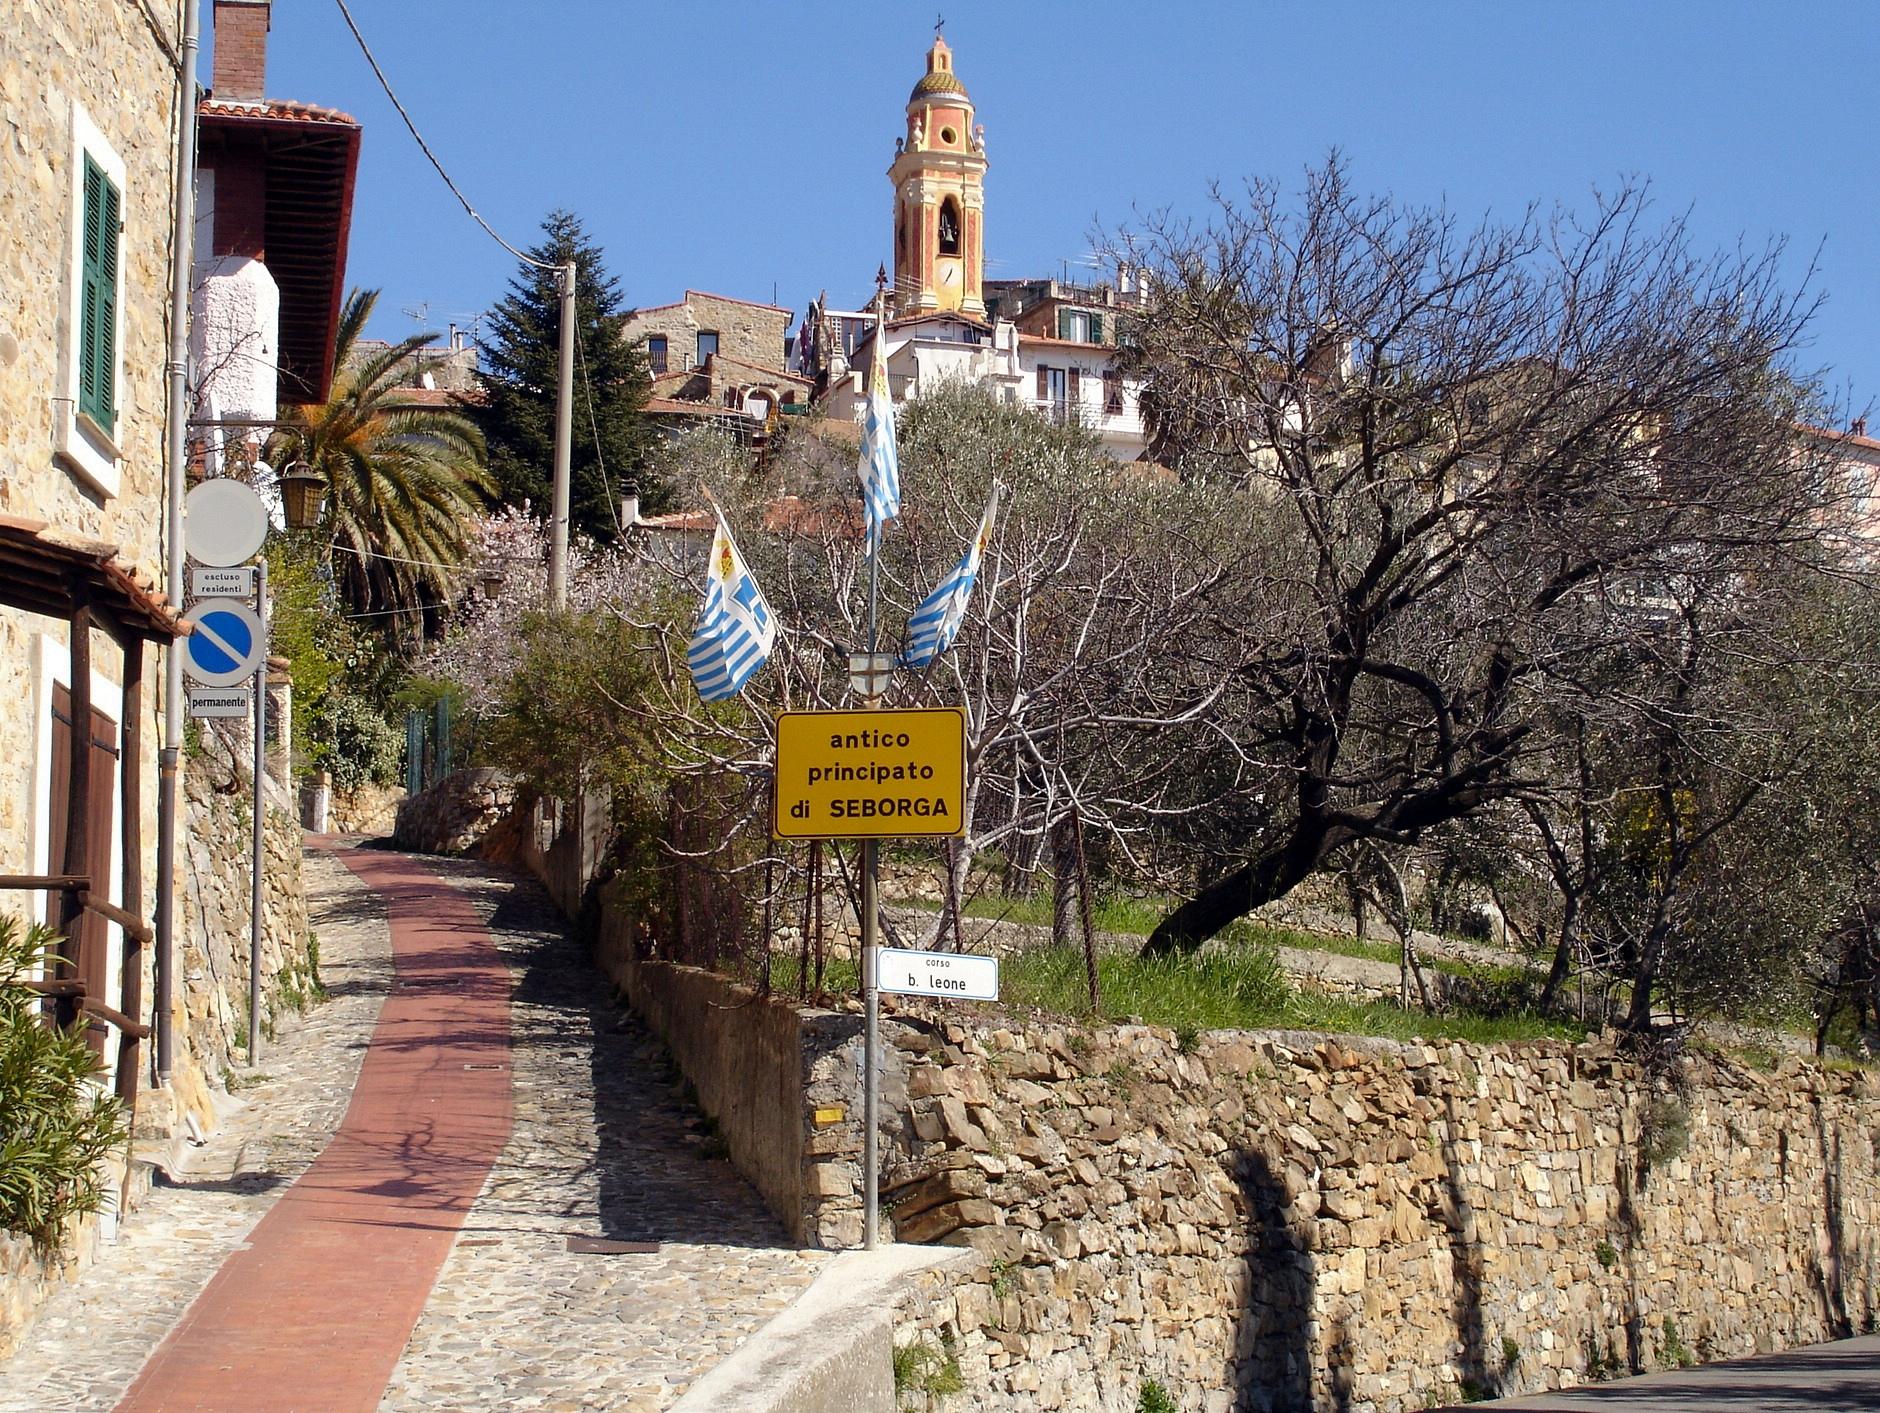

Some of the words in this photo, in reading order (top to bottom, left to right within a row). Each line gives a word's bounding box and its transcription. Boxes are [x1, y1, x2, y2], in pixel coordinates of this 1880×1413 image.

[204, 573, 240, 581] escluso
[201, 585, 242, 593] residenti
[192, 696, 246, 710] permanente
[830, 729, 910, 749] antico
[808, 761, 934, 786] principato
[790, 800, 810, 818] di
[829, 797, 949, 818] SEBORGA
[925, 959, 951, 968] corso
[908, 973, 919, 987] b.
[930, 974, 966, 991] leone
